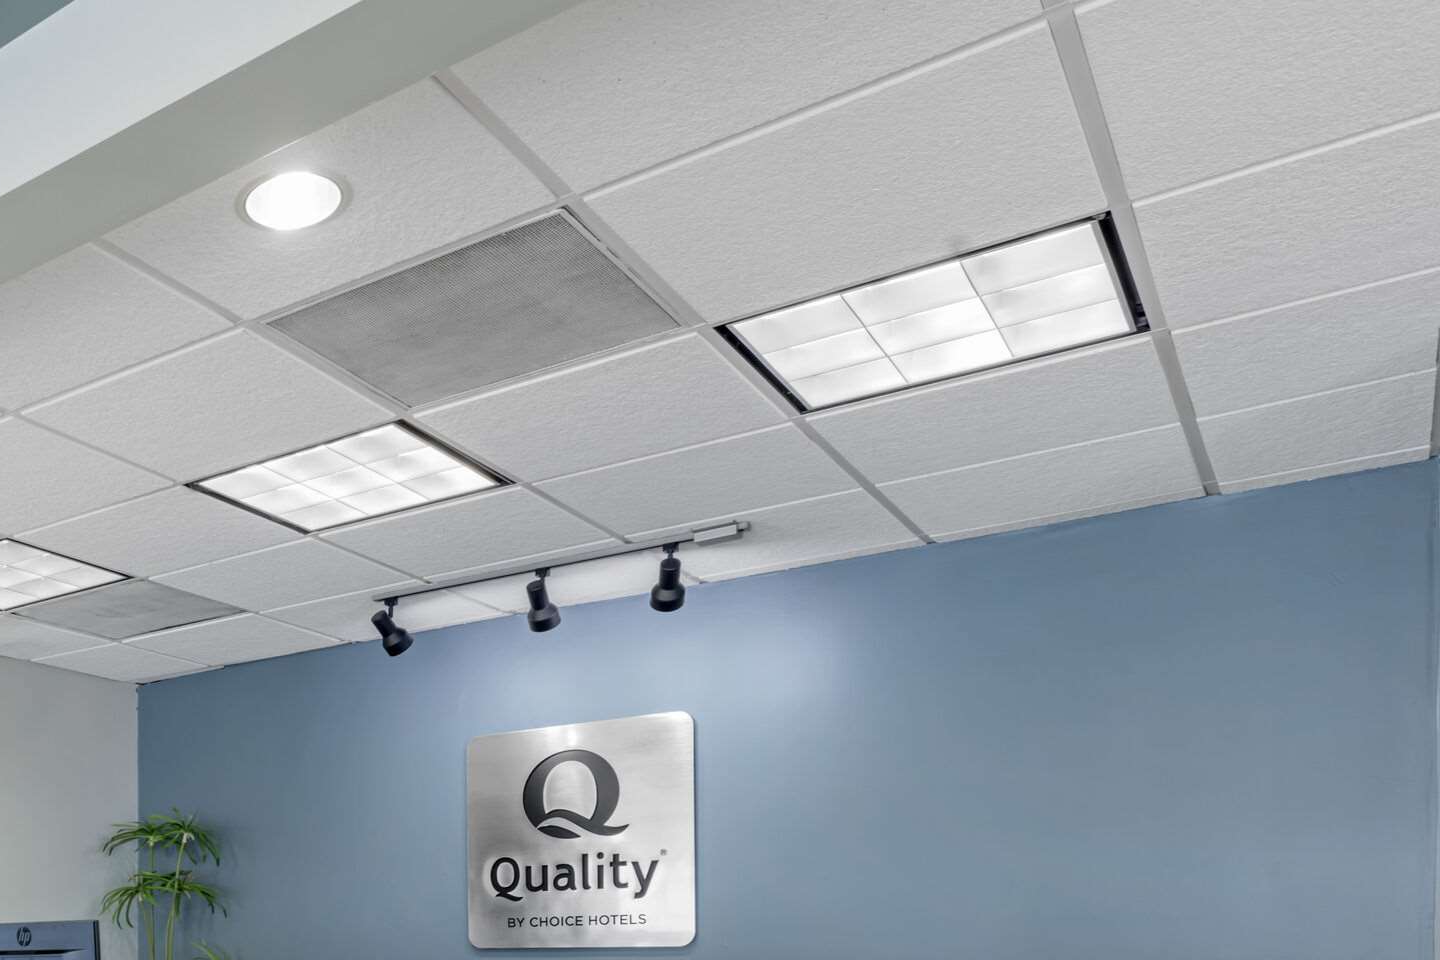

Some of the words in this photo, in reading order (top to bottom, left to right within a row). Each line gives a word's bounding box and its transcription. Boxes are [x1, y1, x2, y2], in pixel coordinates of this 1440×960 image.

[490, 852, 659, 902] Quality
[507, 917, 524, 928] BY
[529, 915, 583, 928] CHOICE
[588, 914, 647, 926] HOTELS
